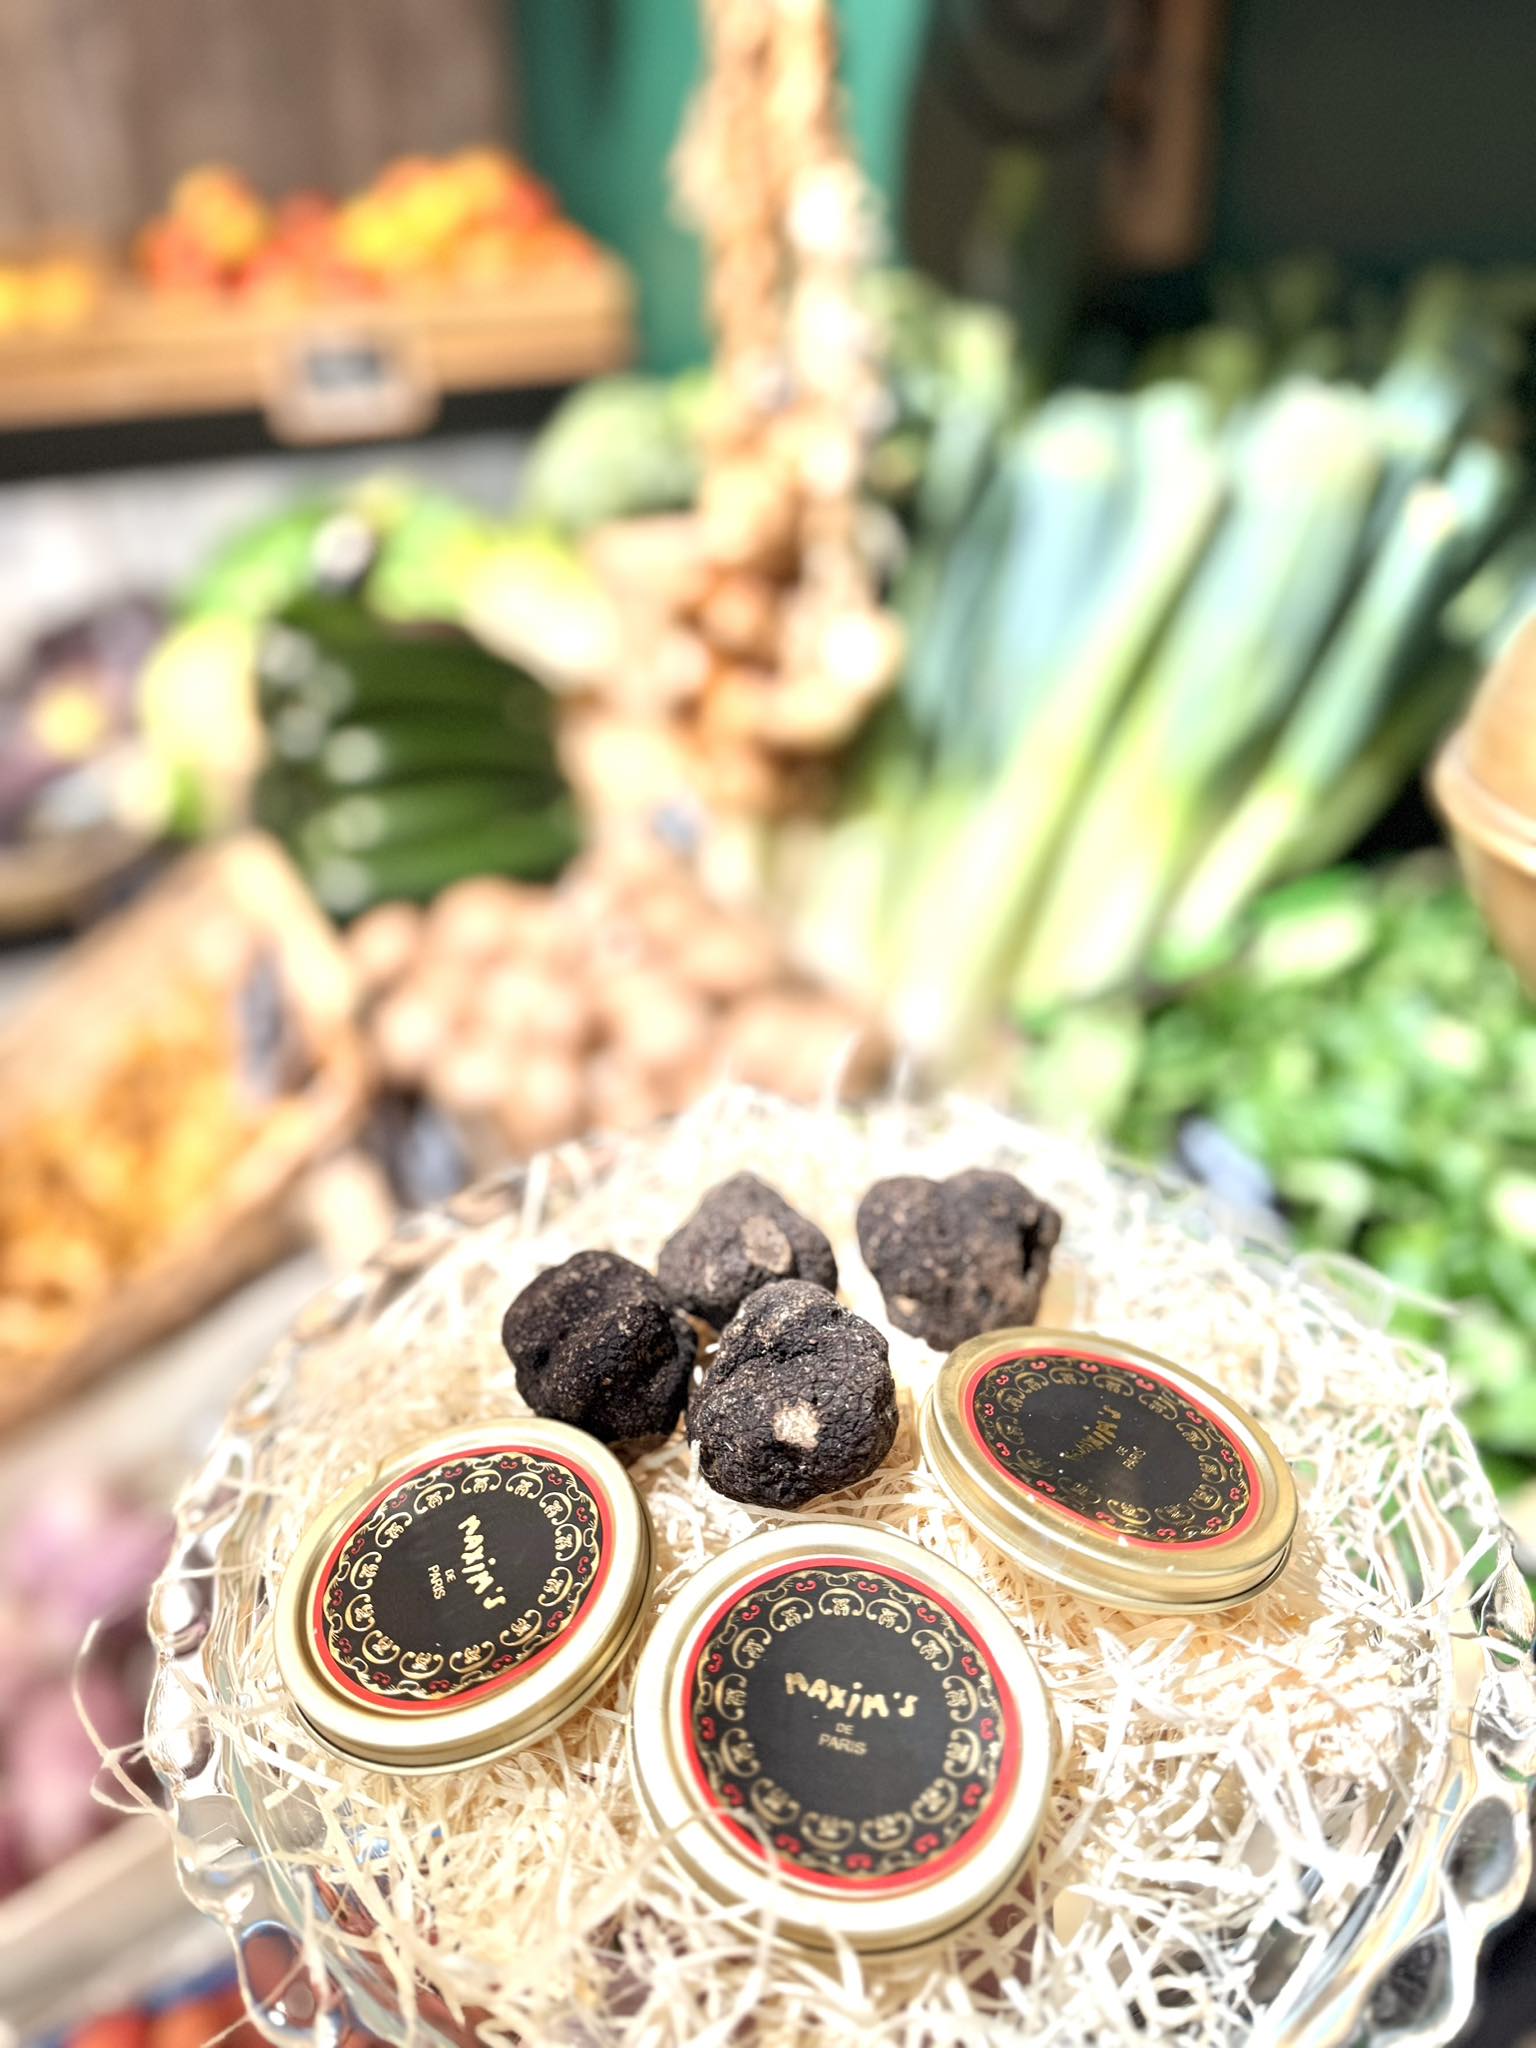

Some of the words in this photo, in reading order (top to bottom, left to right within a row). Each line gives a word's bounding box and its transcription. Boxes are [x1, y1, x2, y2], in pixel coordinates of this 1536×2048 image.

[427, 1564, 446, 1600] PARIS
[444, 1568, 457, 1583] DE
[835, 1722, 854, 1735] DE
[818, 1733, 868, 1756] PARIS
